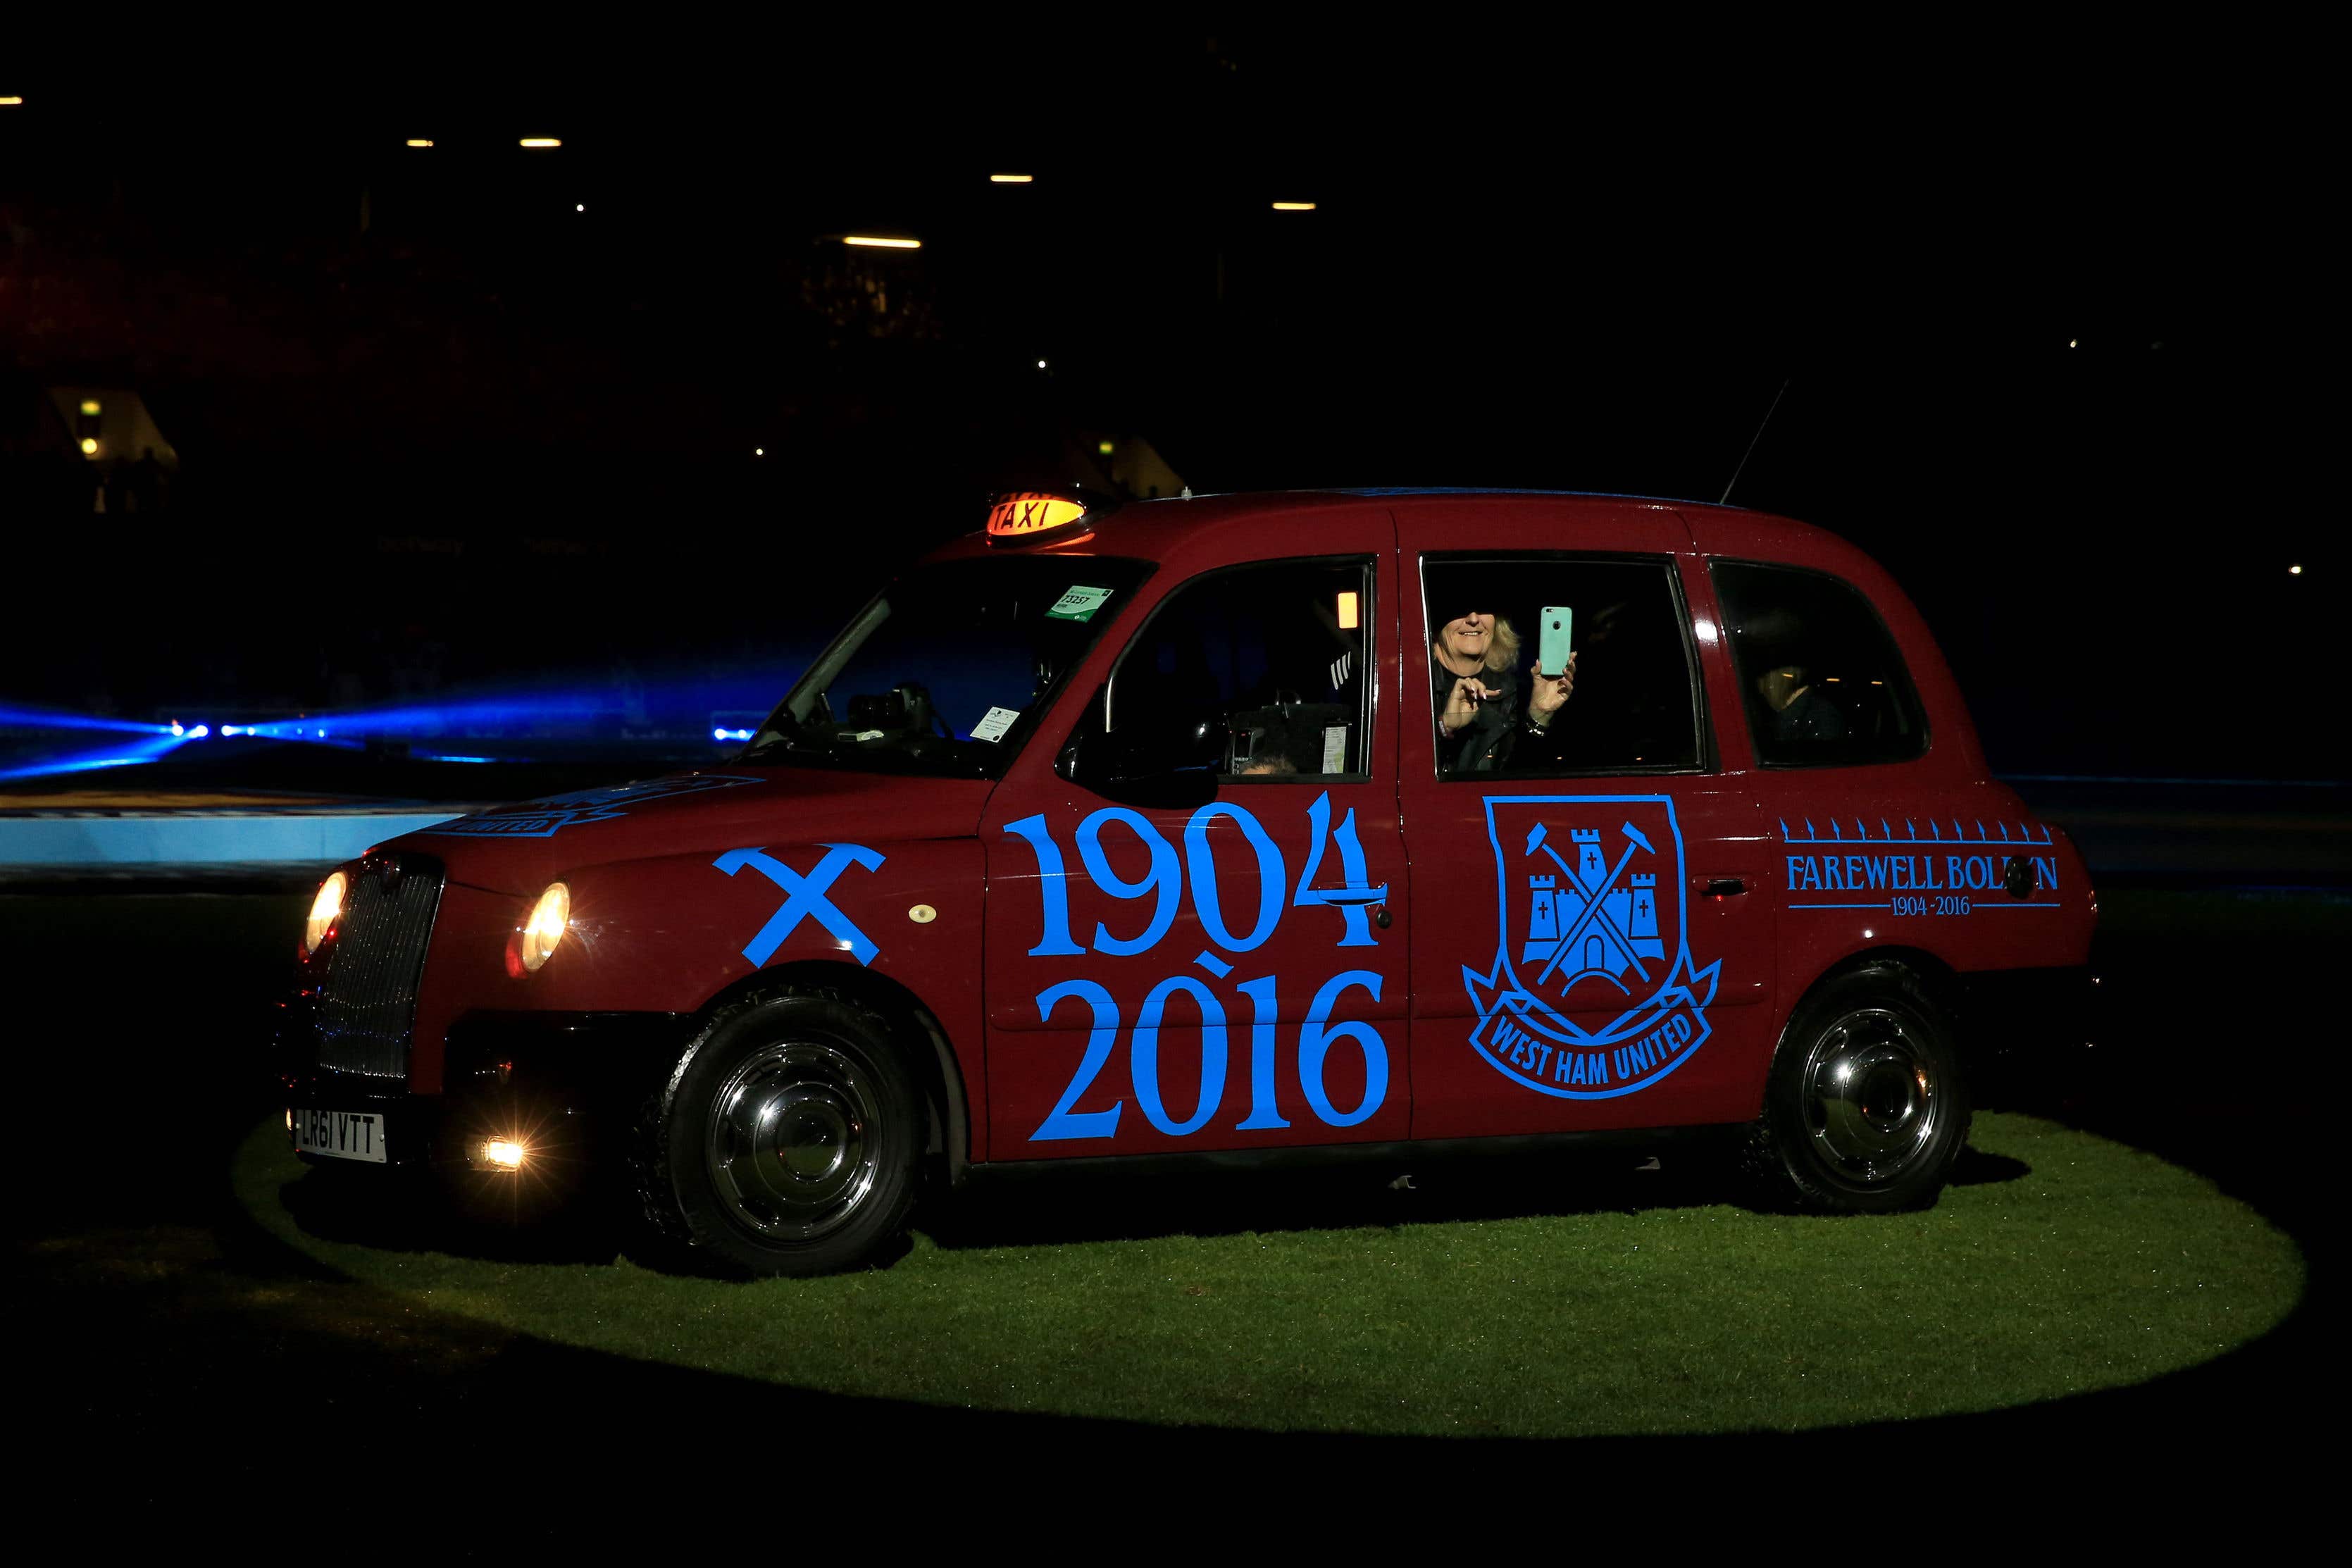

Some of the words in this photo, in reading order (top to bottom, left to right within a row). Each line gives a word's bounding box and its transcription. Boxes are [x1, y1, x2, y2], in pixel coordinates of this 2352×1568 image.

[994, 502, 1050, 530] TAXI
[1003, 790, 1388, 957] 1904
[1786, 856, 1943, 890] FAREWELL
[1946, 855, 2058, 890] BOLN
[1028, 970, 1389, 1141] 2016
[1490, 1015, 1553, 1076] WEST
[1555, 1050, 1609, 1085] HAM
[1614, 1014, 1692, 1079] UNITED
[338, 1112, 375, 1154] VTT
